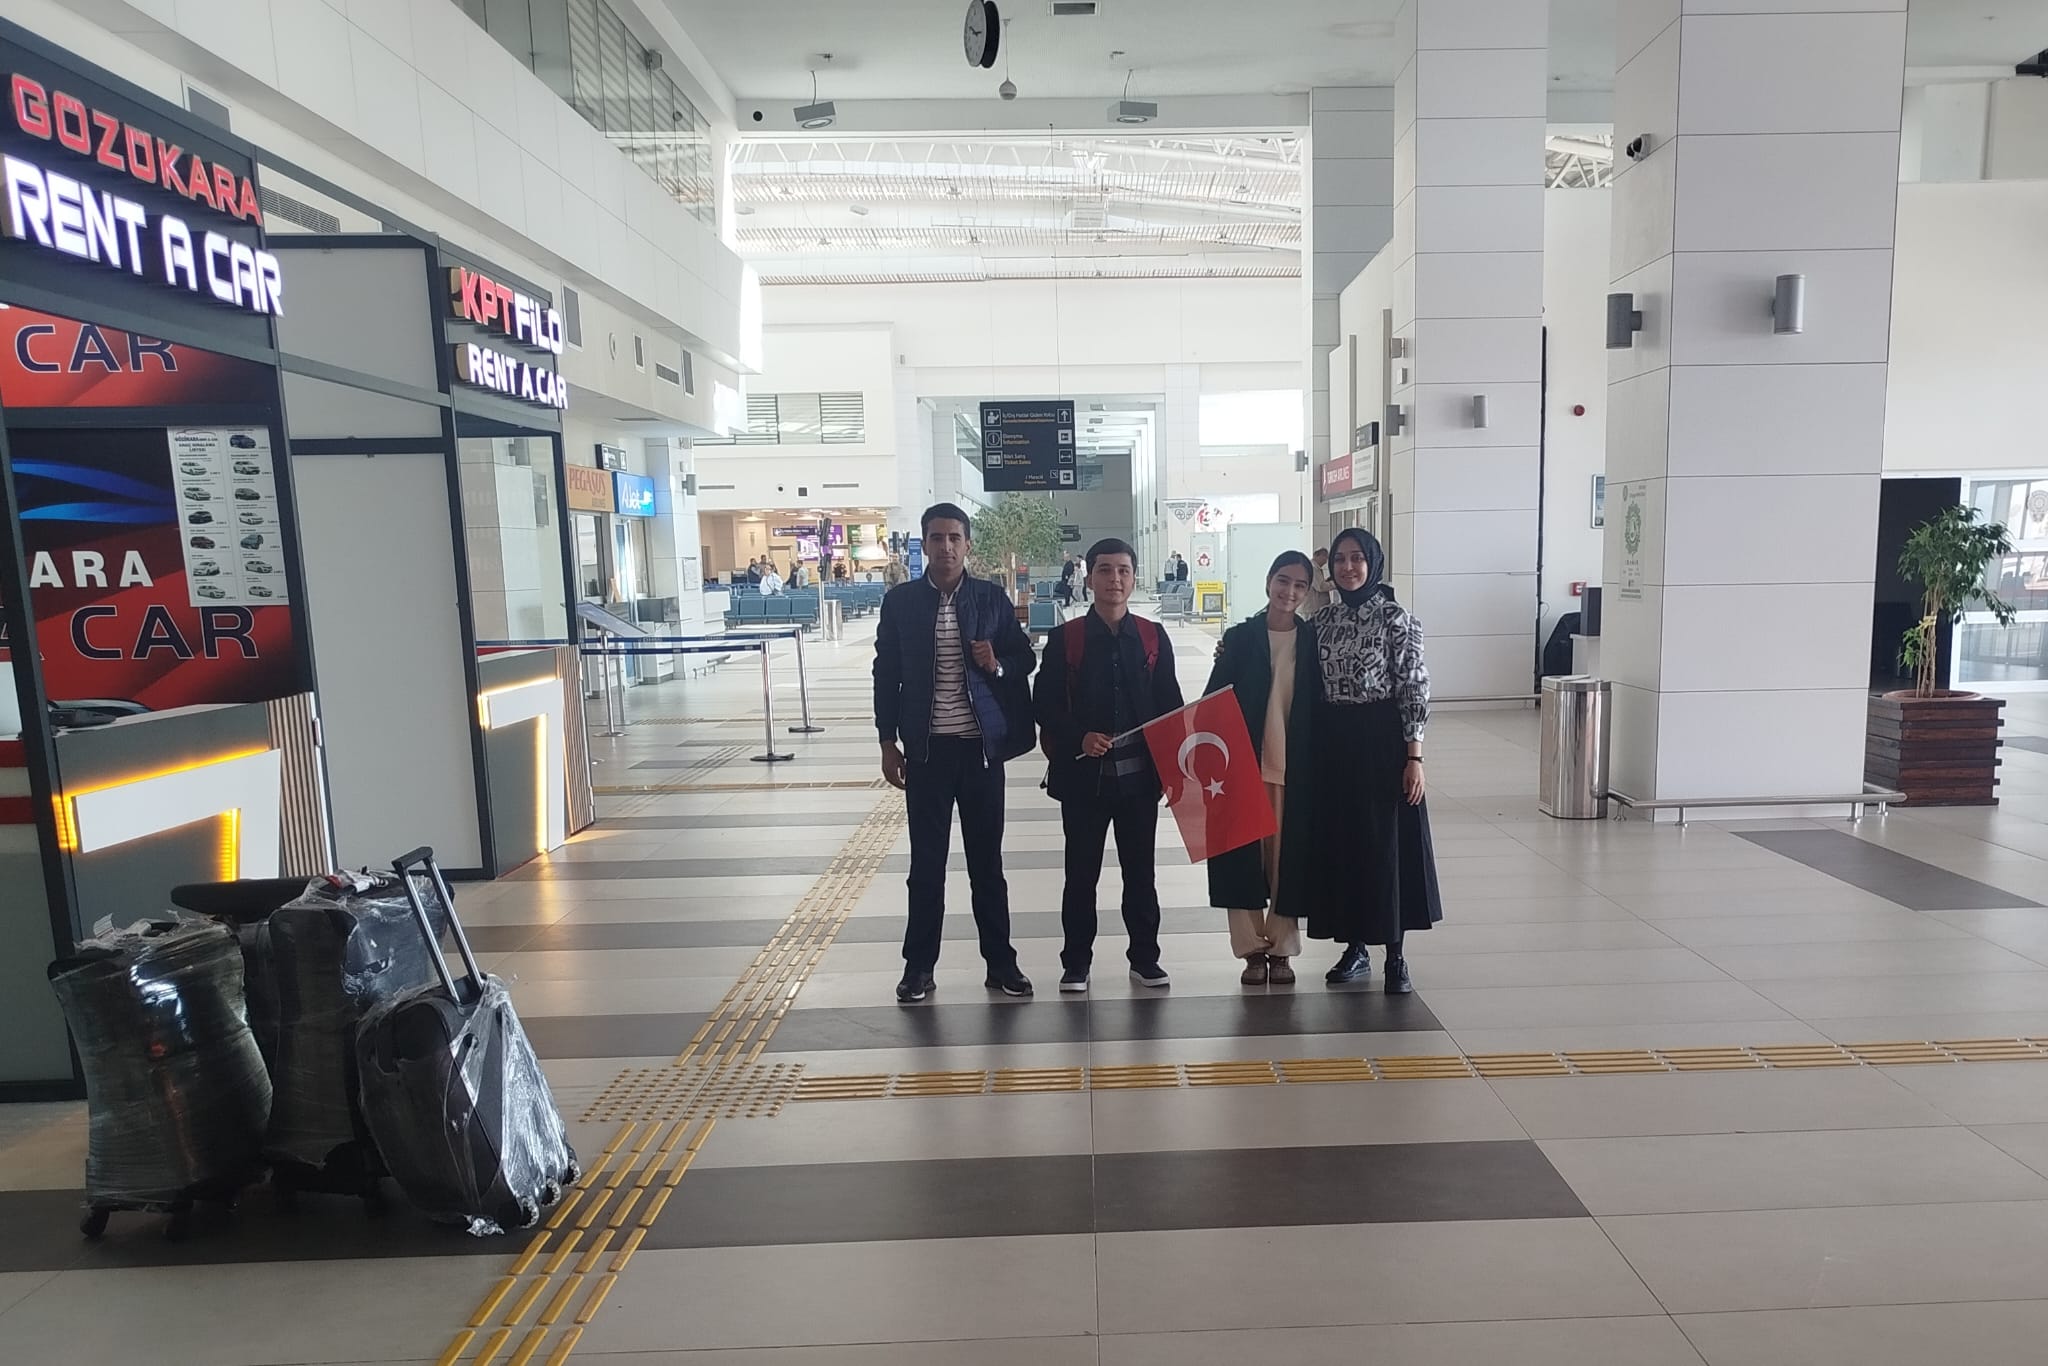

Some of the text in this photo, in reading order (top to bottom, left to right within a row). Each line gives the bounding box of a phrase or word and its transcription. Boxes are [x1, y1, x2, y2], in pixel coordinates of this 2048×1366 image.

[4, 153, 284, 317] RENT A CAR
[15, 323, 178, 374] CAR
[467, 342, 568, 410] RENT A CAR
[569, 467, 606, 497] PEGASUS
[70, 605, 259, 660] CAR
